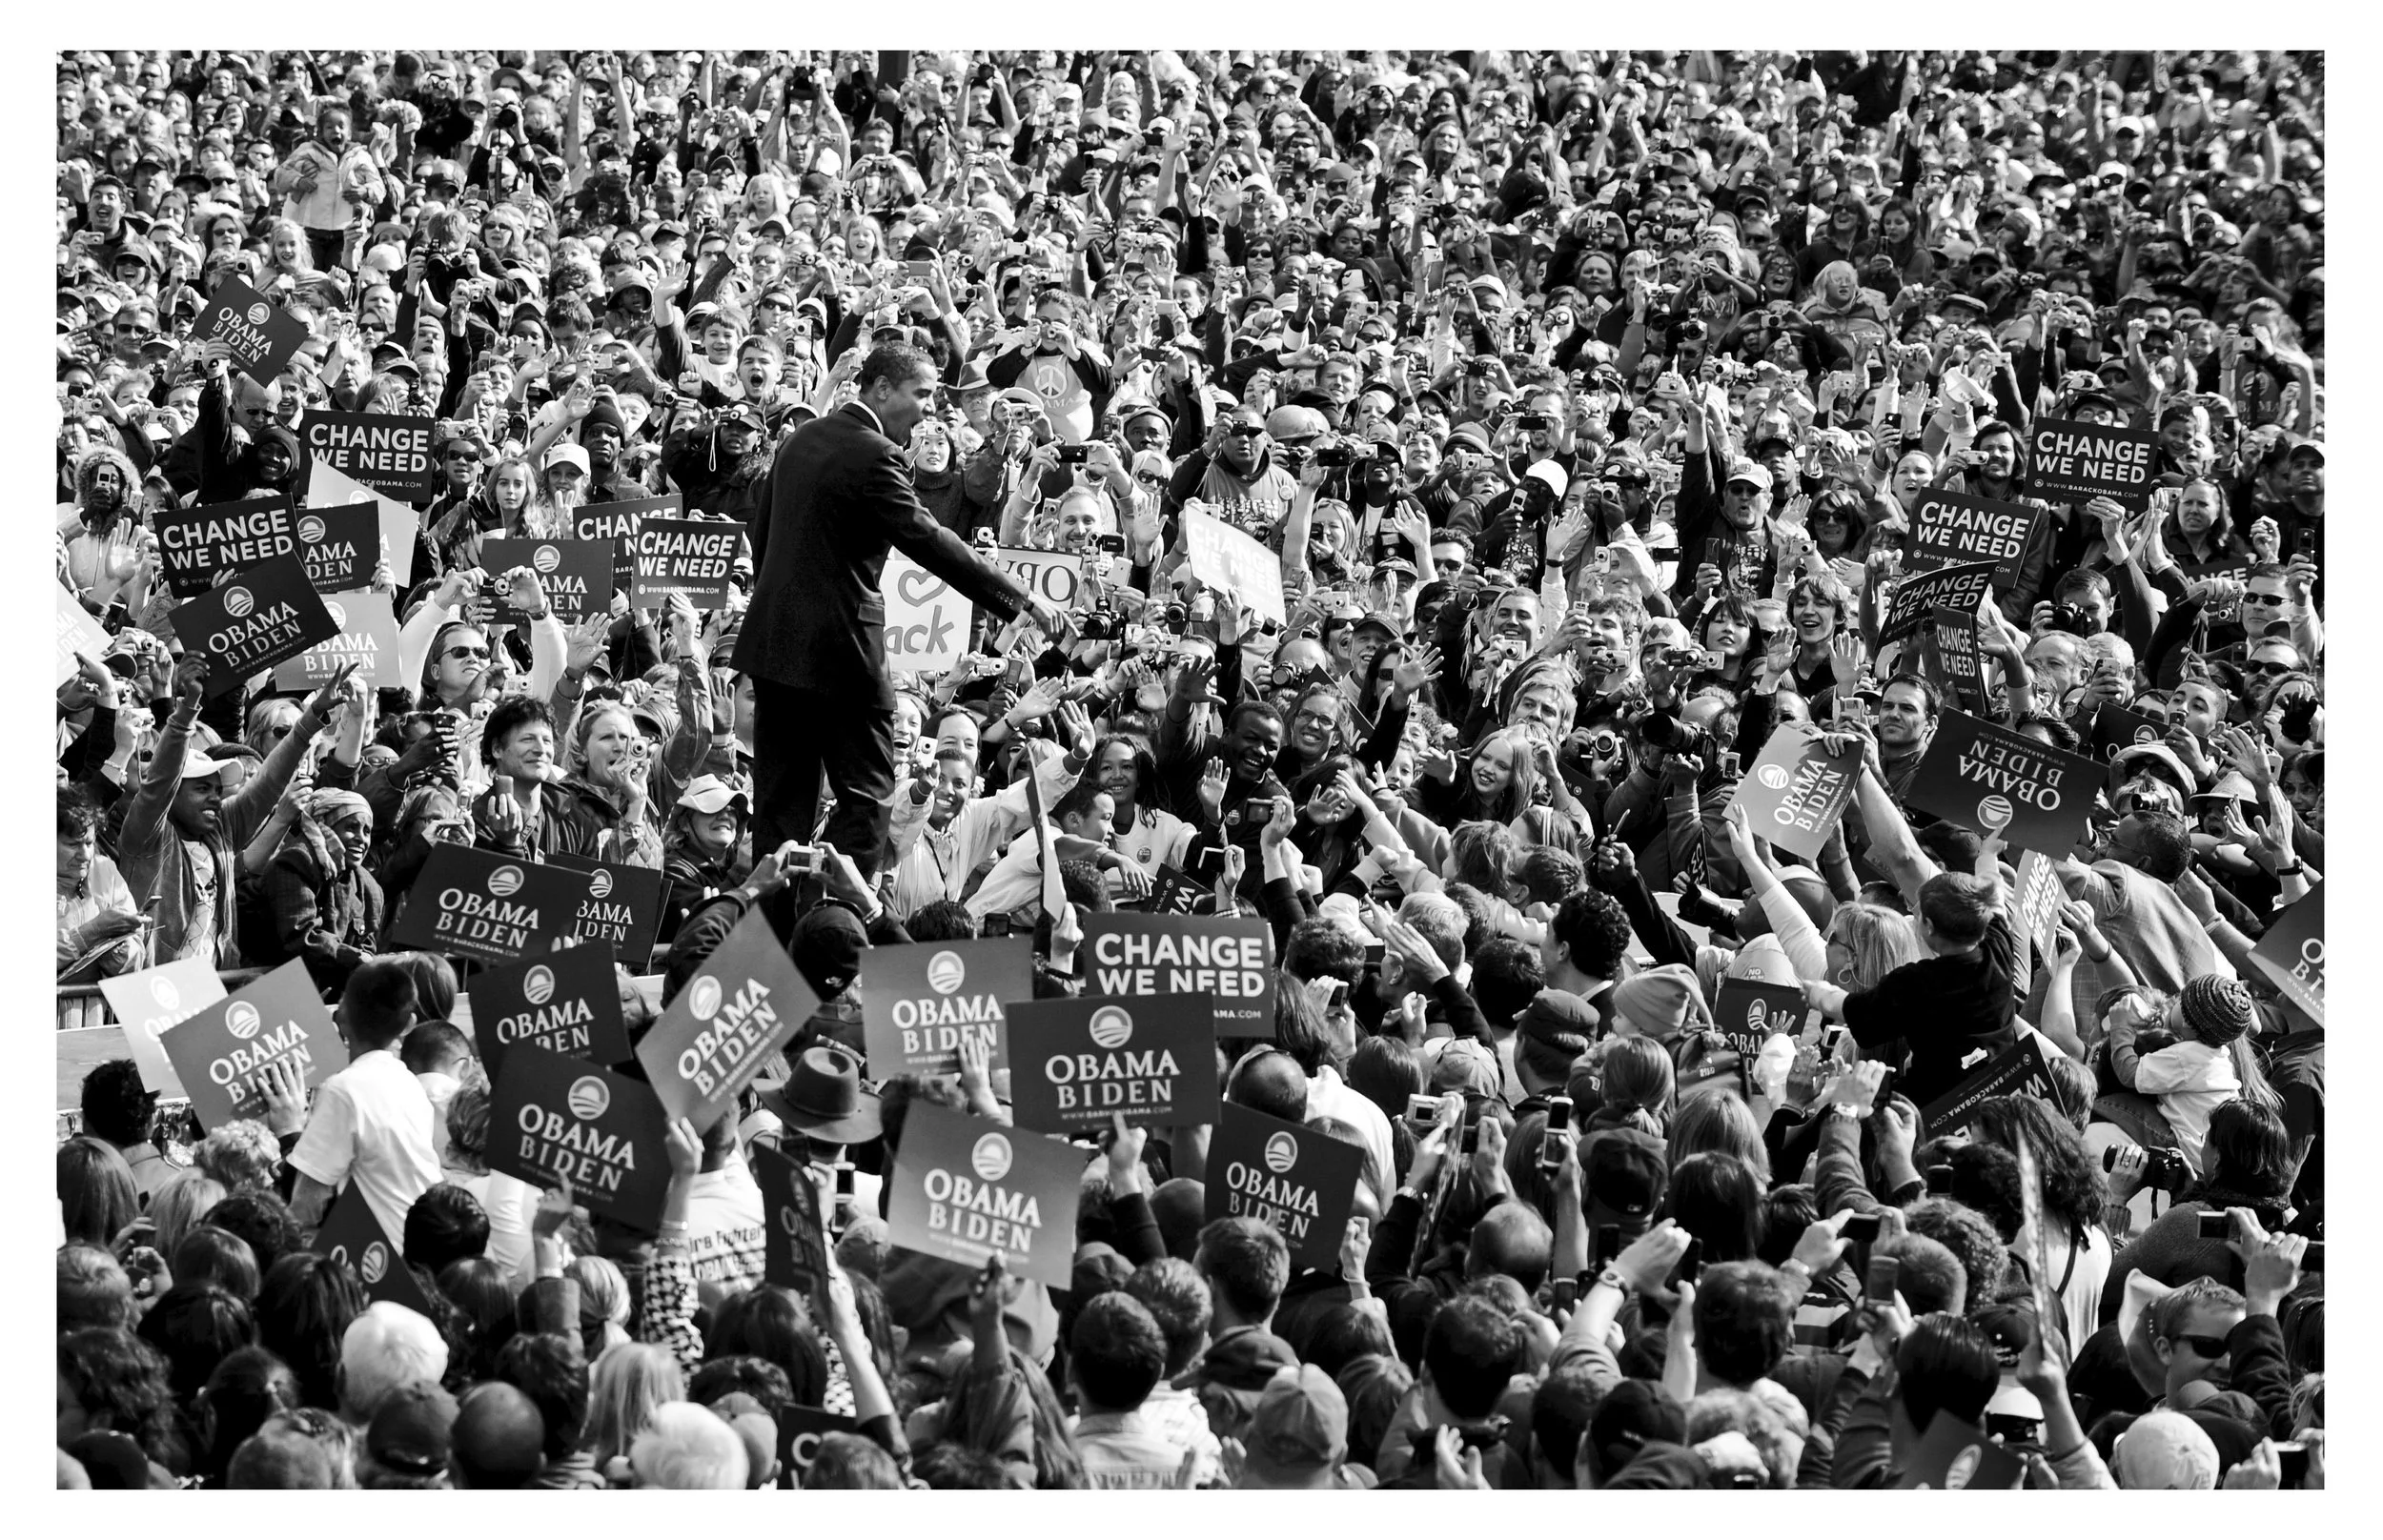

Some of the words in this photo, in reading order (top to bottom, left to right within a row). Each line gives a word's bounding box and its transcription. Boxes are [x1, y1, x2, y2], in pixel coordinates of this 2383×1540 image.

[213, 320, 262, 363] BIDEN
[218, 307, 273, 355] OBAMA
[309, 423, 429, 452] CHANGE
[2037, 431, 2150, 464] CHANGE
[358, 450, 427, 473] NEED
[2035, 454, 2074, 476] WE
[2082, 459, 2146, 484] NEED
[2047, 481, 2139, 498] WWW.BARACKOBAMA.COM
[163, 509, 290, 549] CHANGE
[1920, 501, 2029, 539] CHANGE
[168, 546, 212, 571] WE
[219, 535, 294, 565] NEED
[305, 540, 357, 563] AMA
[640, 531, 736, 557] CHANGE
[1191, 522, 1276, 582] CHANGE
[1917, 523, 1953, 547] WE
[1958, 532, 2021, 558] NEED
[306, 559, 354, 579] DEN
[540, 575, 588, 594] AMA
[638, 557, 668, 578] WE
[672, 557, 727, 578] NEED
[1192, 540, 1221, 570] WE
[1230, 558, 1278, 598] NEED
[1890, 600, 1918, 625] WE
[1921, 592, 1979, 610] NEED
[1896, 573, 1988, 608] CHANGE
[209, 601, 299, 654] OBAMA
[224, 620, 302, 668] BIDEN
[885, 605, 955, 655] ack
[1936, 623, 1972, 654] CHANGE
[1939, 651, 1951, 674] WE
[1950, 654, 1976, 678] NEED
[1958, 755, 2061, 811] OBAMA
[1968, 740, 2065, 788] BIDEN
[1773, 759, 1828, 825] OBAMA
[1794, 769, 1843, 832] BIDEN
[438, 887, 540, 930] OBAMA
[2022, 852, 2050, 929] CHANGE
[2038, 872, 2059, 924] NEED
[436, 911, 529, 949] BIDEN
[574, 919, 627, 942] IDEN
[576, 900, 634, 925] BAMA
[1095, 933, 1264, 969] CHANGE
[2033, 914, 2047, 950] WE
[1097, 968, 1156, 996] WE
[1170, 968, 1265, 998] NEED
[497, 997, 594, 1044] OBAMA
[678, 978, 771, 1081] OBAMA
[891, 993, 1005, 1029] OBAMA
[209, 1019, 310, 1085] OBAMA
[694, 1000, 777, 1097] BIDEN
[902, 1023, 998, 1054] BIDEN
[1045, 1048, 1181, 1084] OBAMA
[1057, 1079, 1172, 1109] BIDEN
[1929, 1062, 2024, 1129] WWW.BARACKOBAMA.COM
[518, 1104, 636, 1171] OBAMA
[518, 1134, 624, 1192] BIDEN
[923, 1168, 1043, 1228] OBAMA
[1226, 1162, 1320, 1218] OBAMA
[928, 1202, 1033, 1254] BIDEN
[1229, 1191, 1311, 1239] BIDEN
